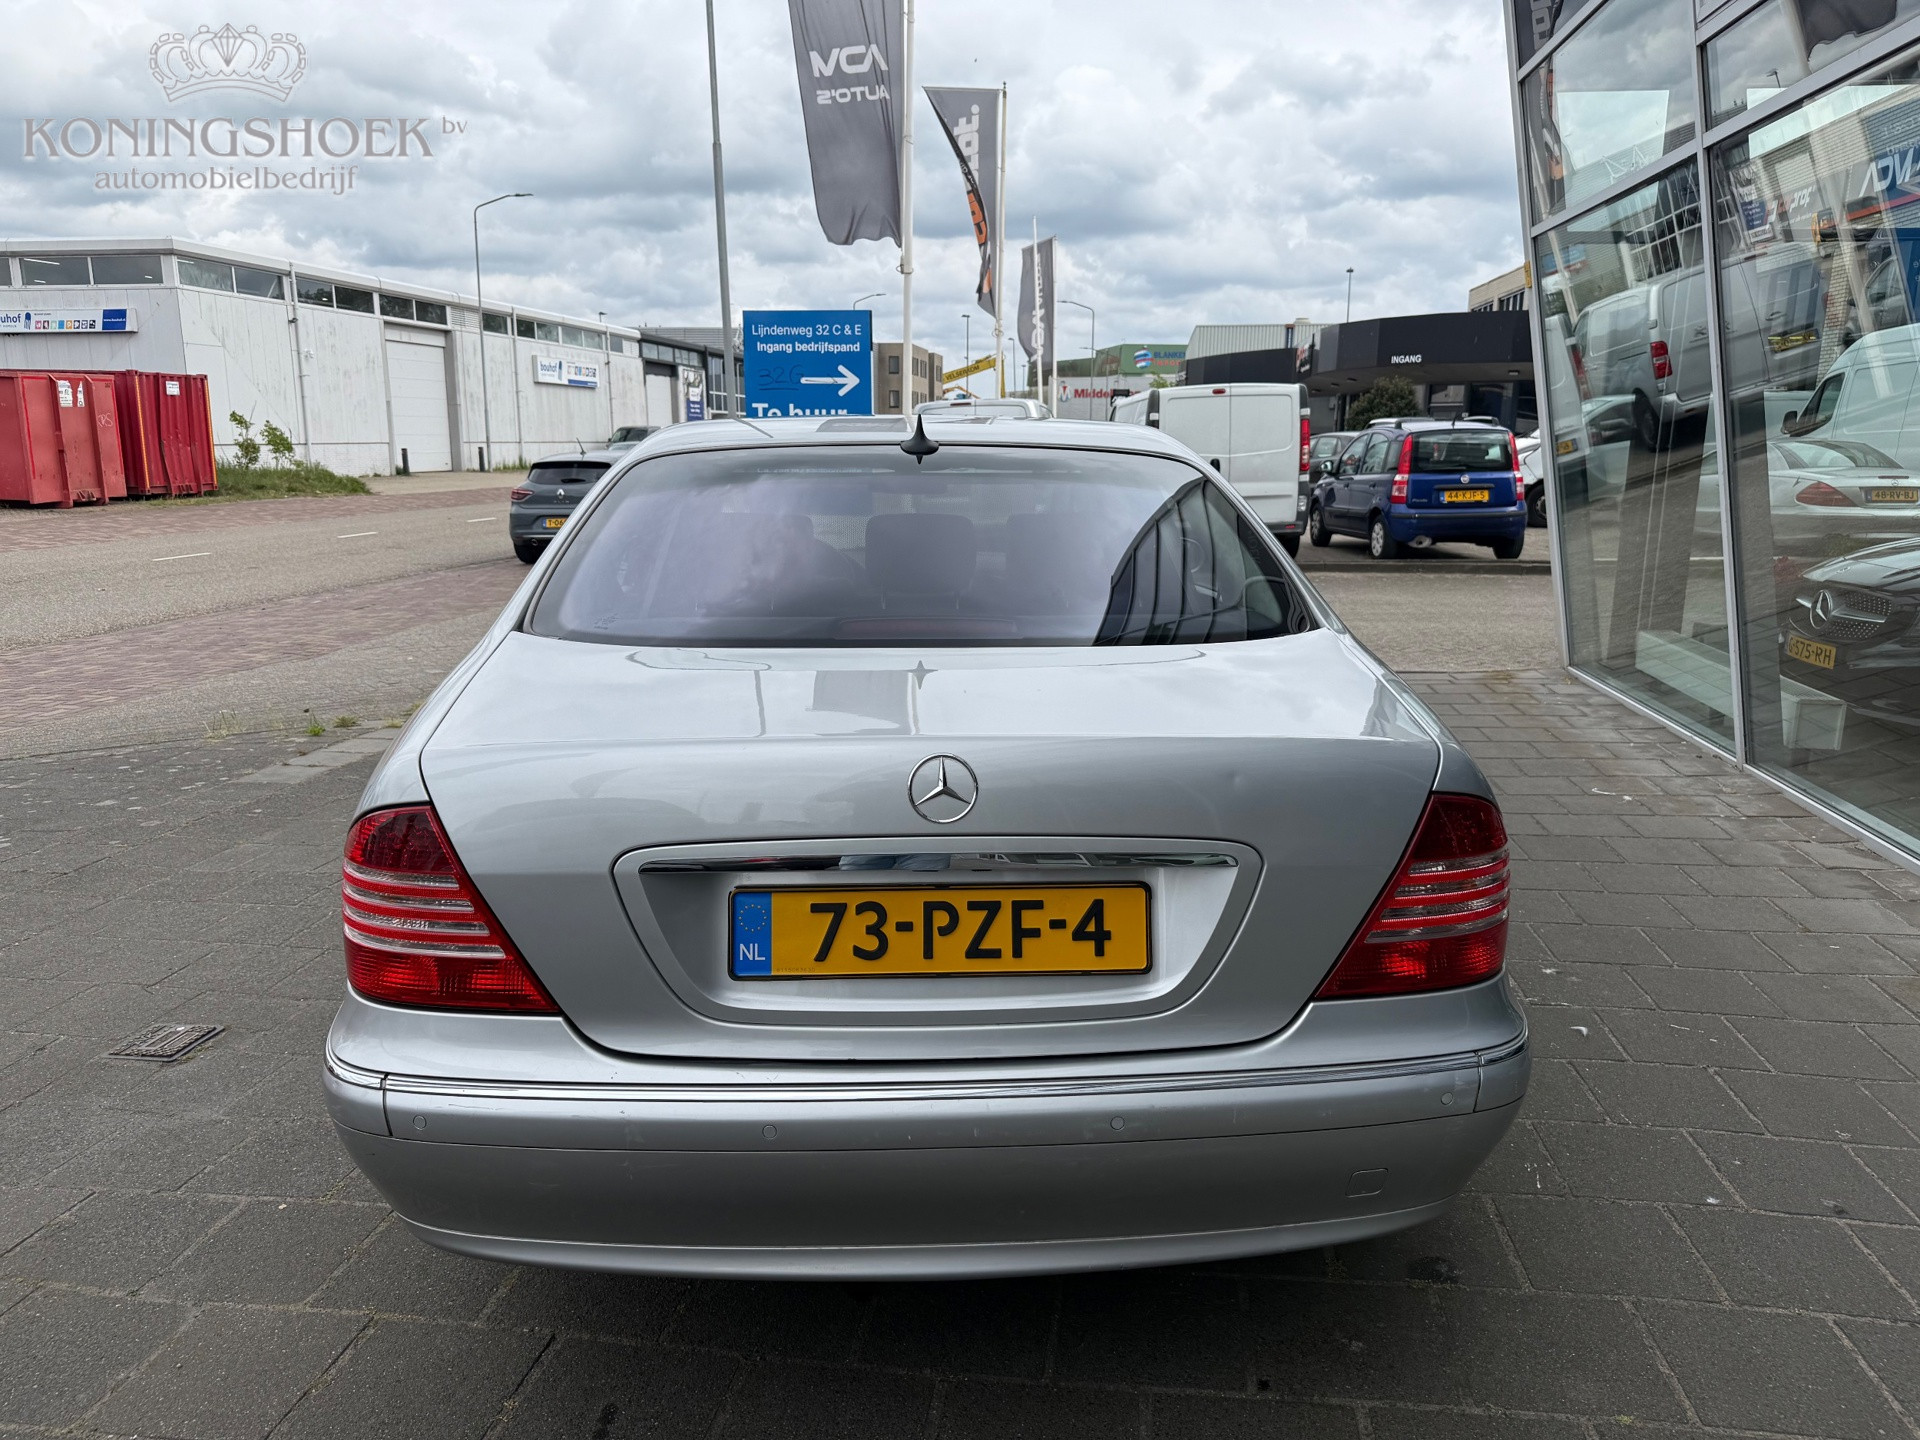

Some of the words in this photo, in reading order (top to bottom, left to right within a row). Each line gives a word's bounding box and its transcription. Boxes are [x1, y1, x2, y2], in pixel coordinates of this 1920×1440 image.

[752, 324, 813, 338] Lijndenweg
[815, 325, 829, 335] 32
[832, 325, 841, 335] C
[844, 325, 852, 335] &
[855, 325, 861, 335] E
[757, 342, 793, 353] Ingang
[795, 342, 860, 354] bedrijfspand
[1391, 354, 1422, 363] INGANG
[1789, 639, 1832, 666] G-575-RH
[810, 899, 1112, 962] 73-PZF-4
[740, 943, 765, 960] NL
